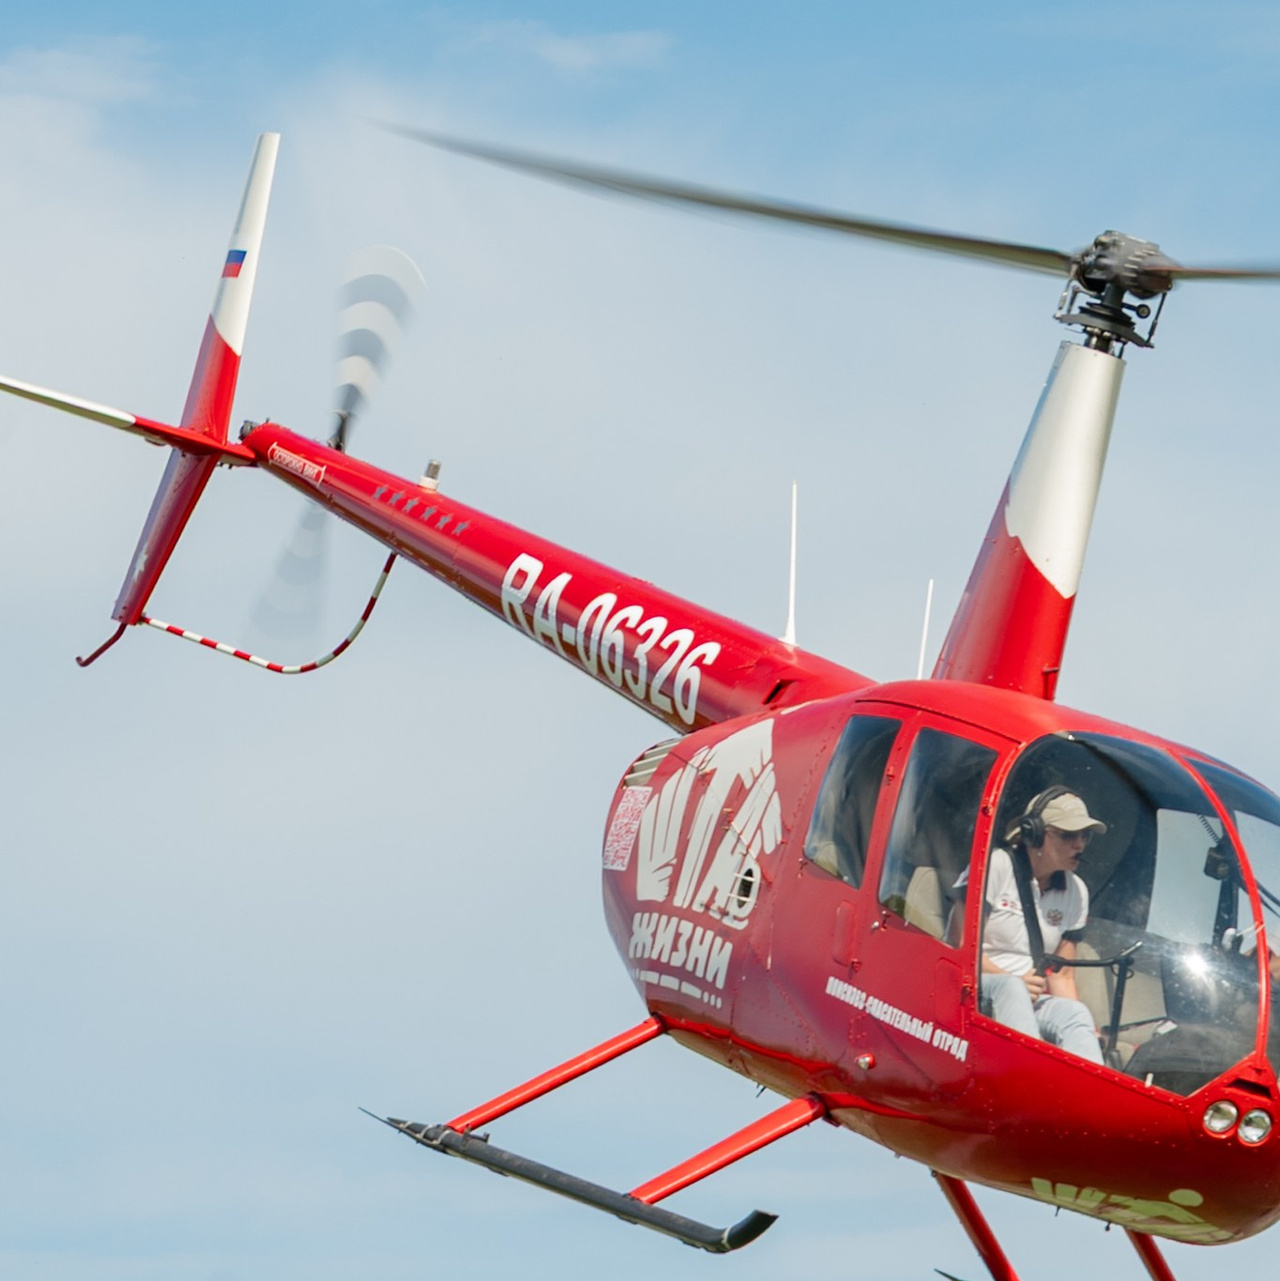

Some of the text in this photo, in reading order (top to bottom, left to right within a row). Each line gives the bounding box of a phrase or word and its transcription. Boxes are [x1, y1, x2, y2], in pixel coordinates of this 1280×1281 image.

[502, 553, 721, 725] RA-06326
[628, 912, 733, 990] ЖИЗНИ
[932, 1028, 969, 1062] ОТРЯД
